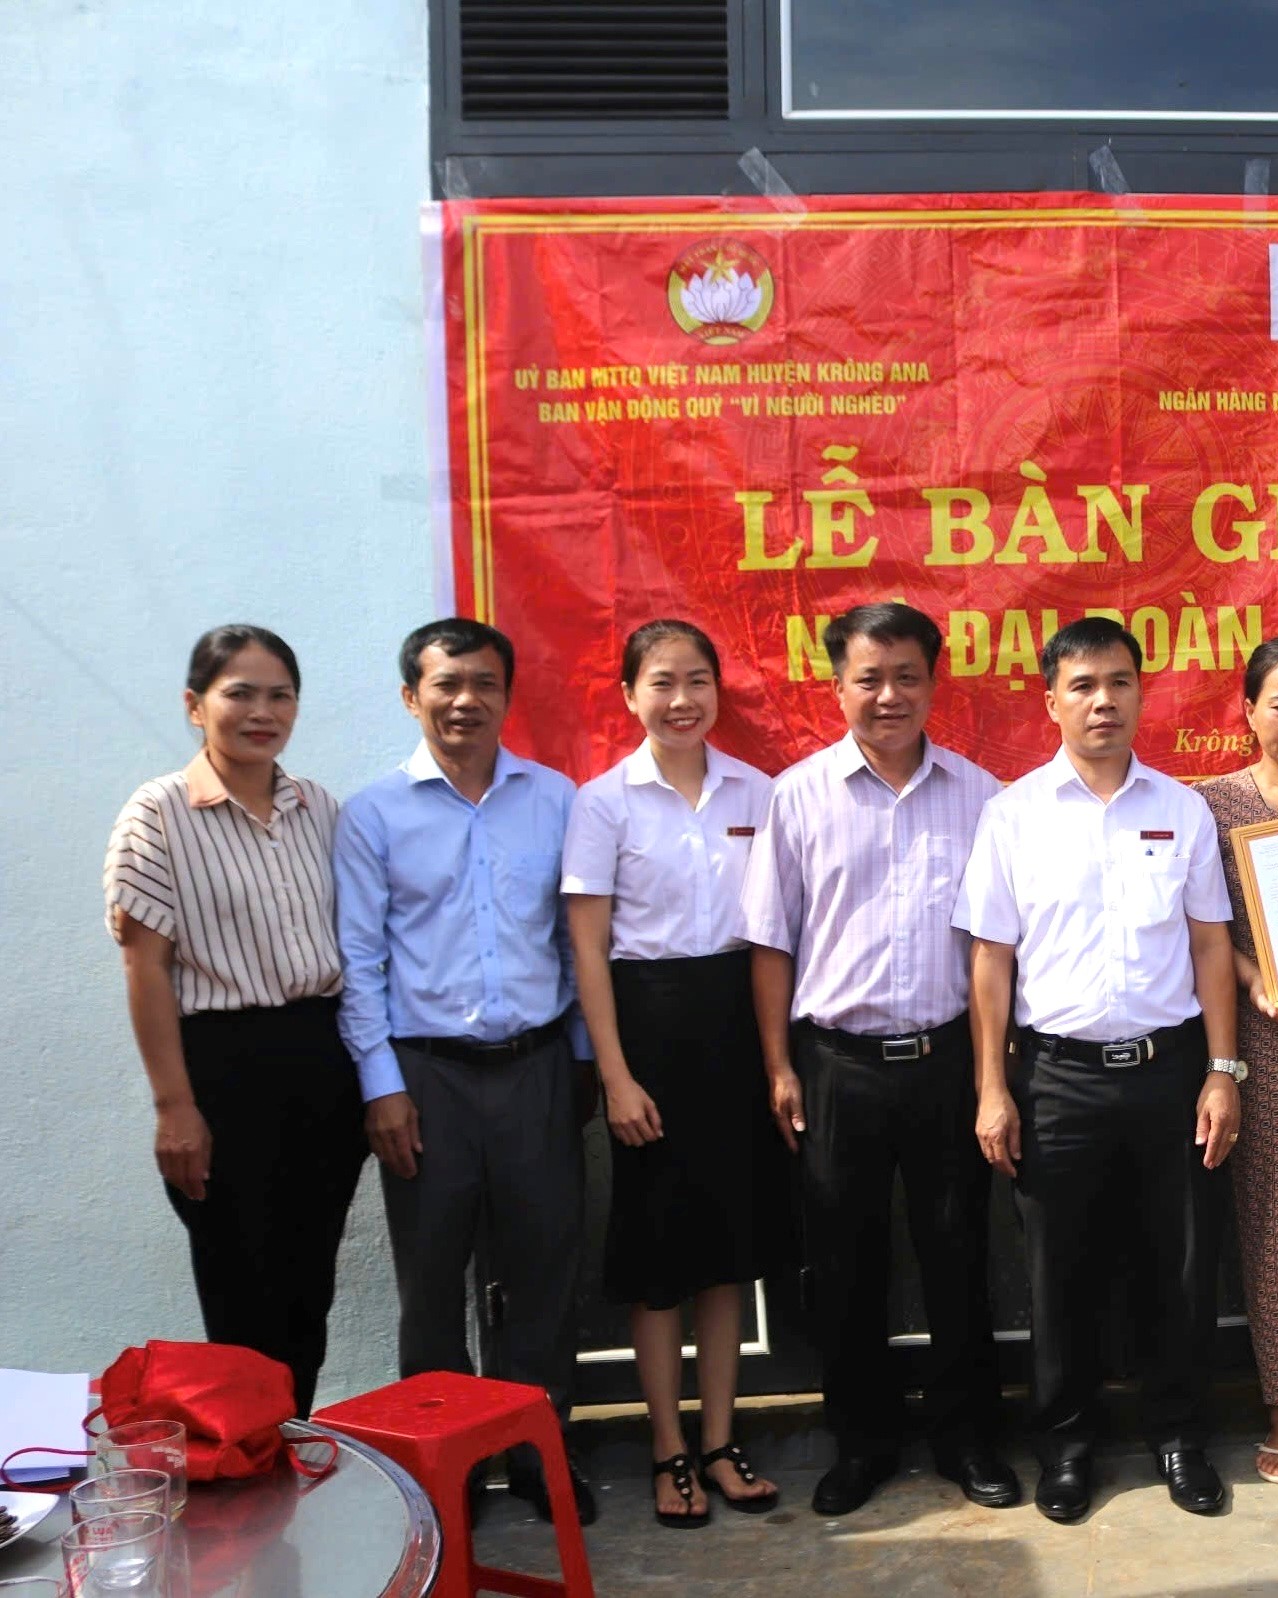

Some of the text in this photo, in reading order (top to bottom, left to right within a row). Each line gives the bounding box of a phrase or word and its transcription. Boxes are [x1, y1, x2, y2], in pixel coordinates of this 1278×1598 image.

[546, 368, 585, 389] BAN
[591, 366, 642, 387] MTTQ
[647, 361, 689, 389] VIỆT
[695, 364, 741, 385] NAM
[747, 359, 810, 388] HUYỆN
[817, 358, 884, 382] KRÔNG
[890, 363, 930, 382] ANA
[539, 402, 579, 423] BAN
[585, 396, 621, 425] VẬN
[627, 395, 680, 423] ĐỘNG
[686, 393, 723, 420] QUỸ
[766, 392, 824, 416] NGƯỜI
[1159, 387, 1210, 411] NGÂN
[1216, 387, 1266, 411] HÀNG
[734, 444, 880, 571] LỄ
[921, 460, 1151, 566] BÀN
[1085, 591, 1262, 673] OÀN
[1173, 727, 1255, 756] Krông
